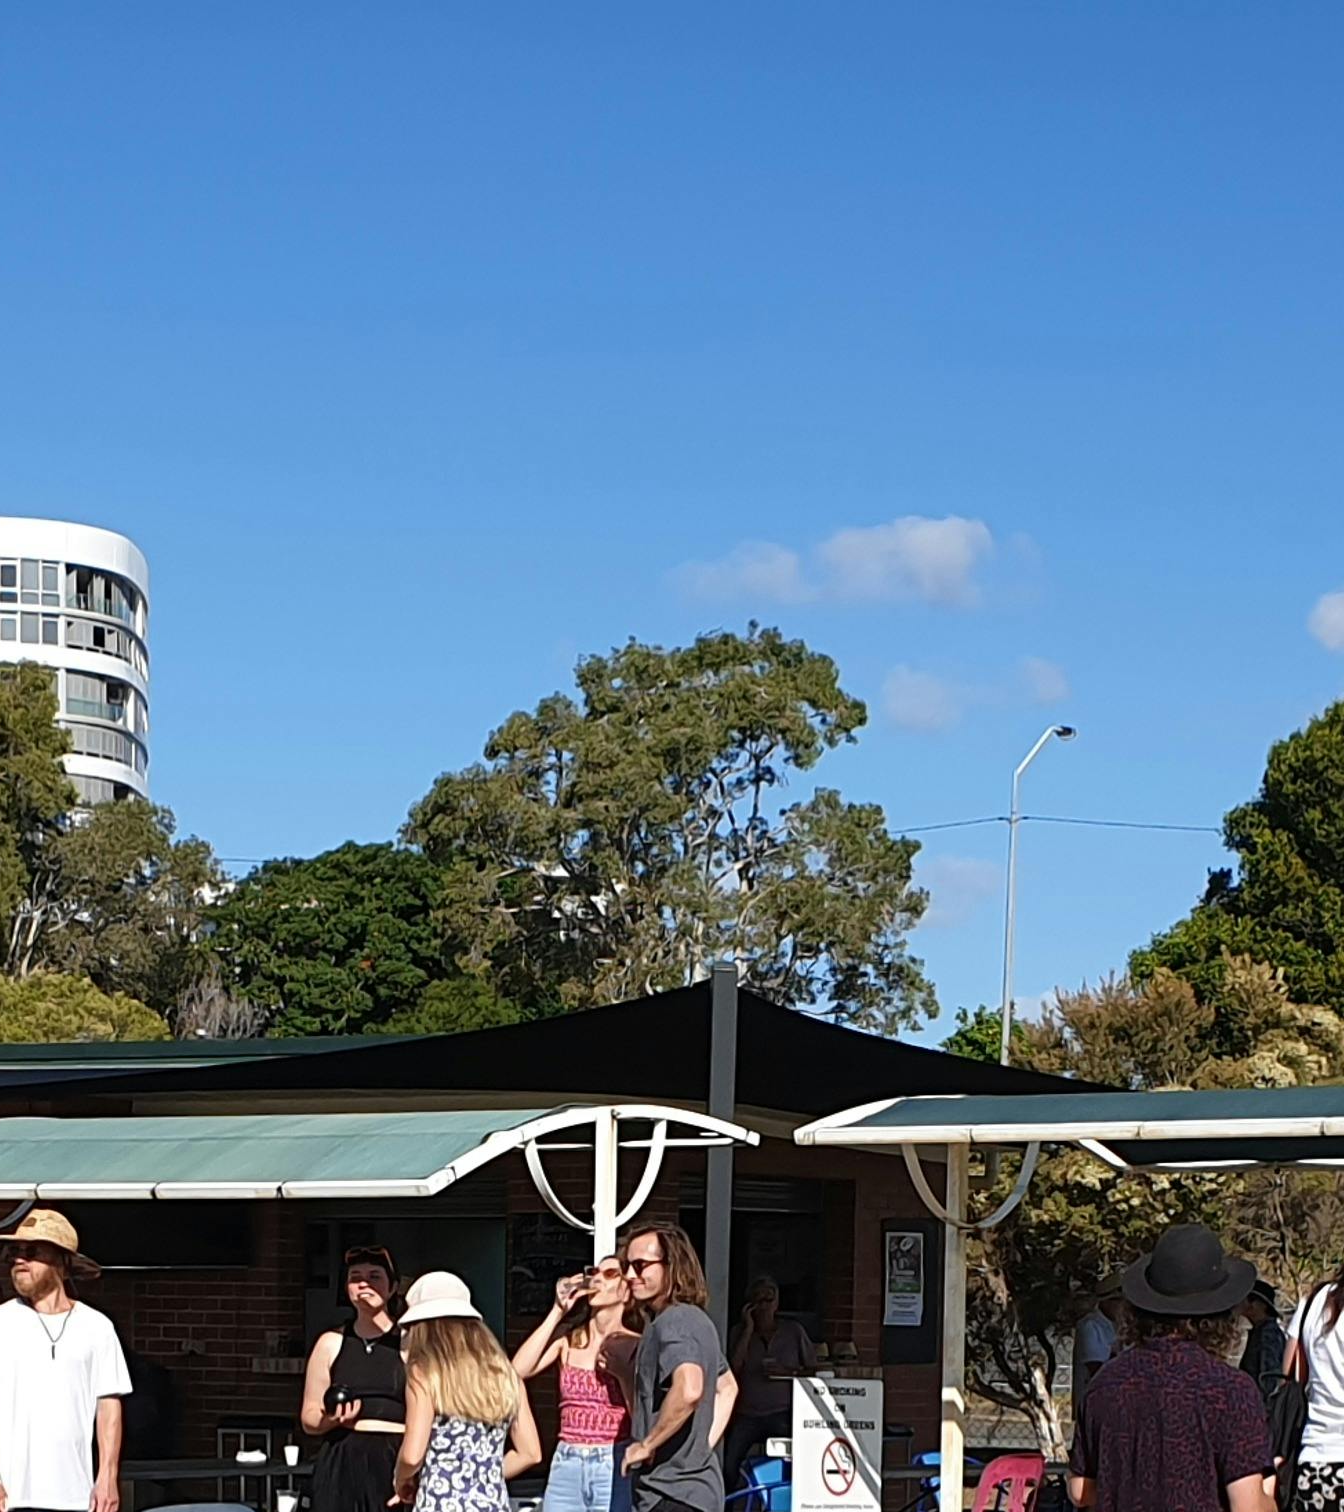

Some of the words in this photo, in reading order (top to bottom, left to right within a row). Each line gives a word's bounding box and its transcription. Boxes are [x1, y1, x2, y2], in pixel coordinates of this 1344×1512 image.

[813, 1385, 826, 1396] NO
[827, 1385, 867, 1397] SMOKING
[834, 1403, 846, 1413] ON
[803, 1419, 841, 1430] BOWLING
[843, 1419, 875, 1430] GREENS
